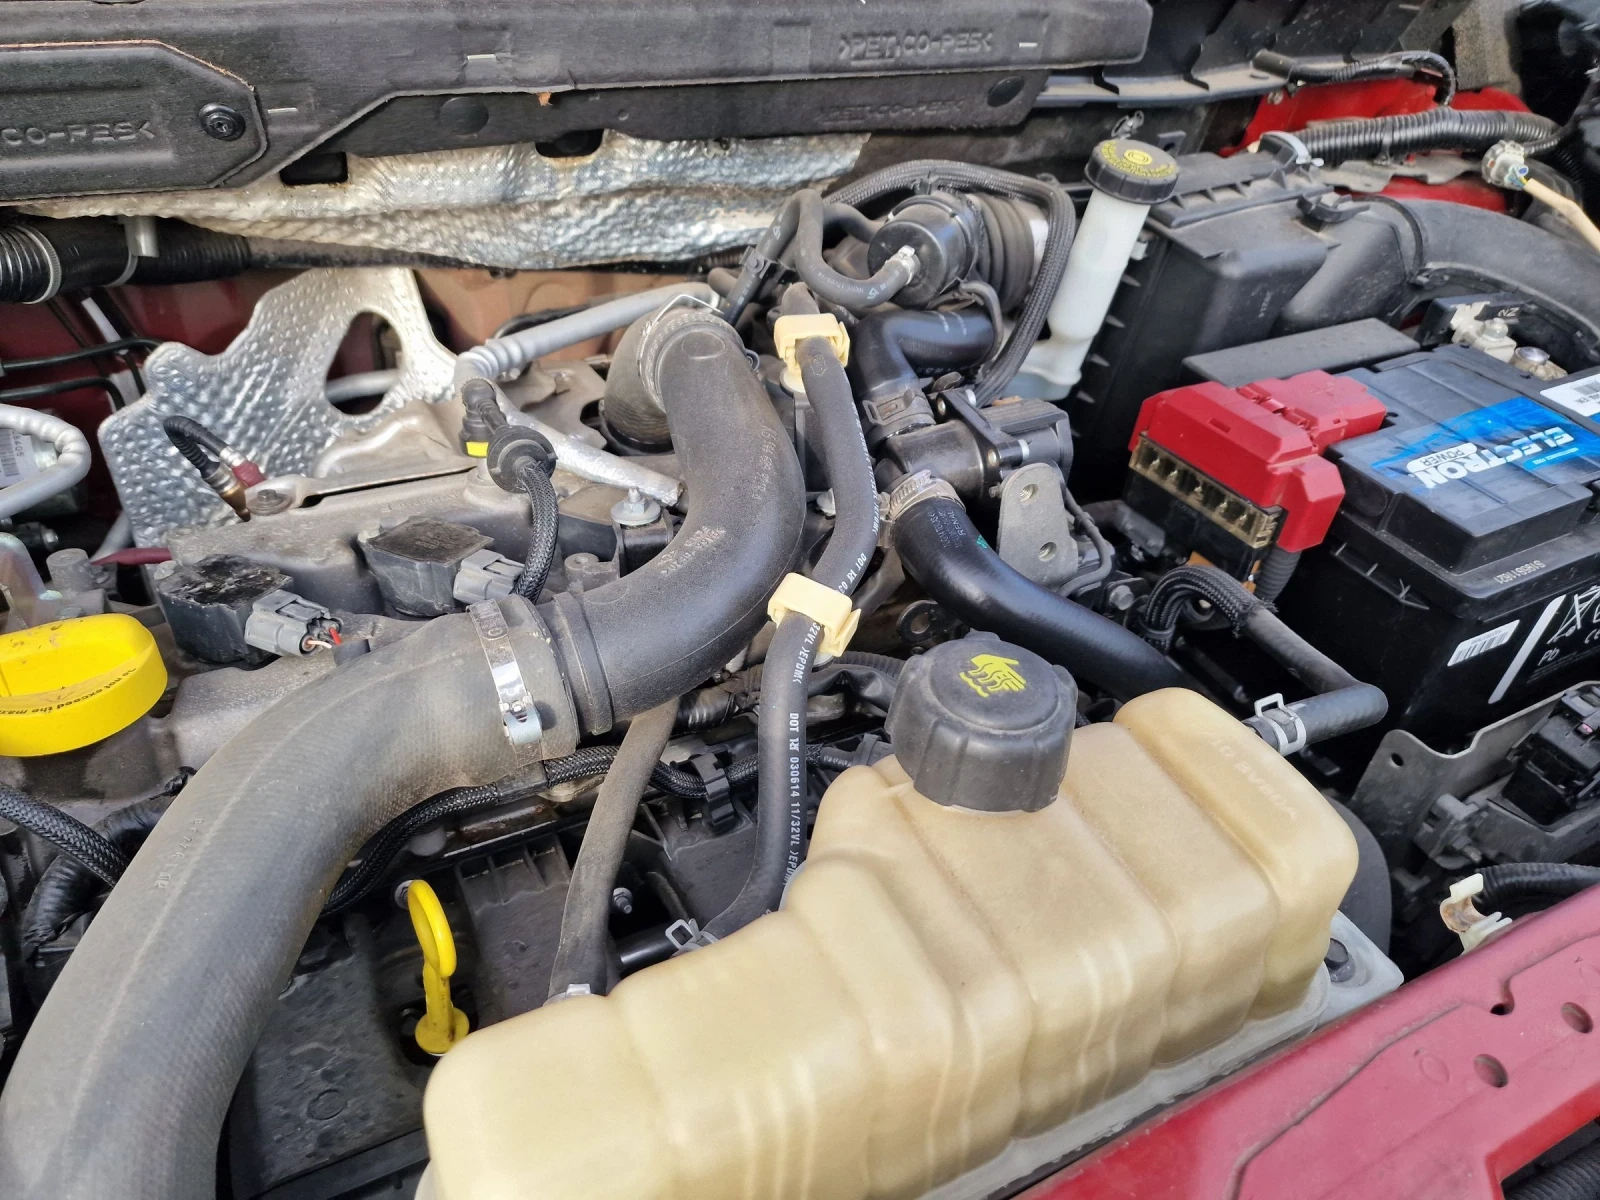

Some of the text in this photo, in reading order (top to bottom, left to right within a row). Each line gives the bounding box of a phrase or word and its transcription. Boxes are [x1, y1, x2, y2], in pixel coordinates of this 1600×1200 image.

[1412, 426, 1574, 489] ELECTRON
[1419, 449, 1465, 467] POWER
[855, 552, 867, 571] DOT
[1537, 647, 1560, 667] Pb
[57, 688, 103, 709] exceed
[31, 706, 53, 714] the
[789, 712, 799, 732] DOT
[790, 756, 800, 797] 030614
[790, 801, 801, 847] 11/32VL
